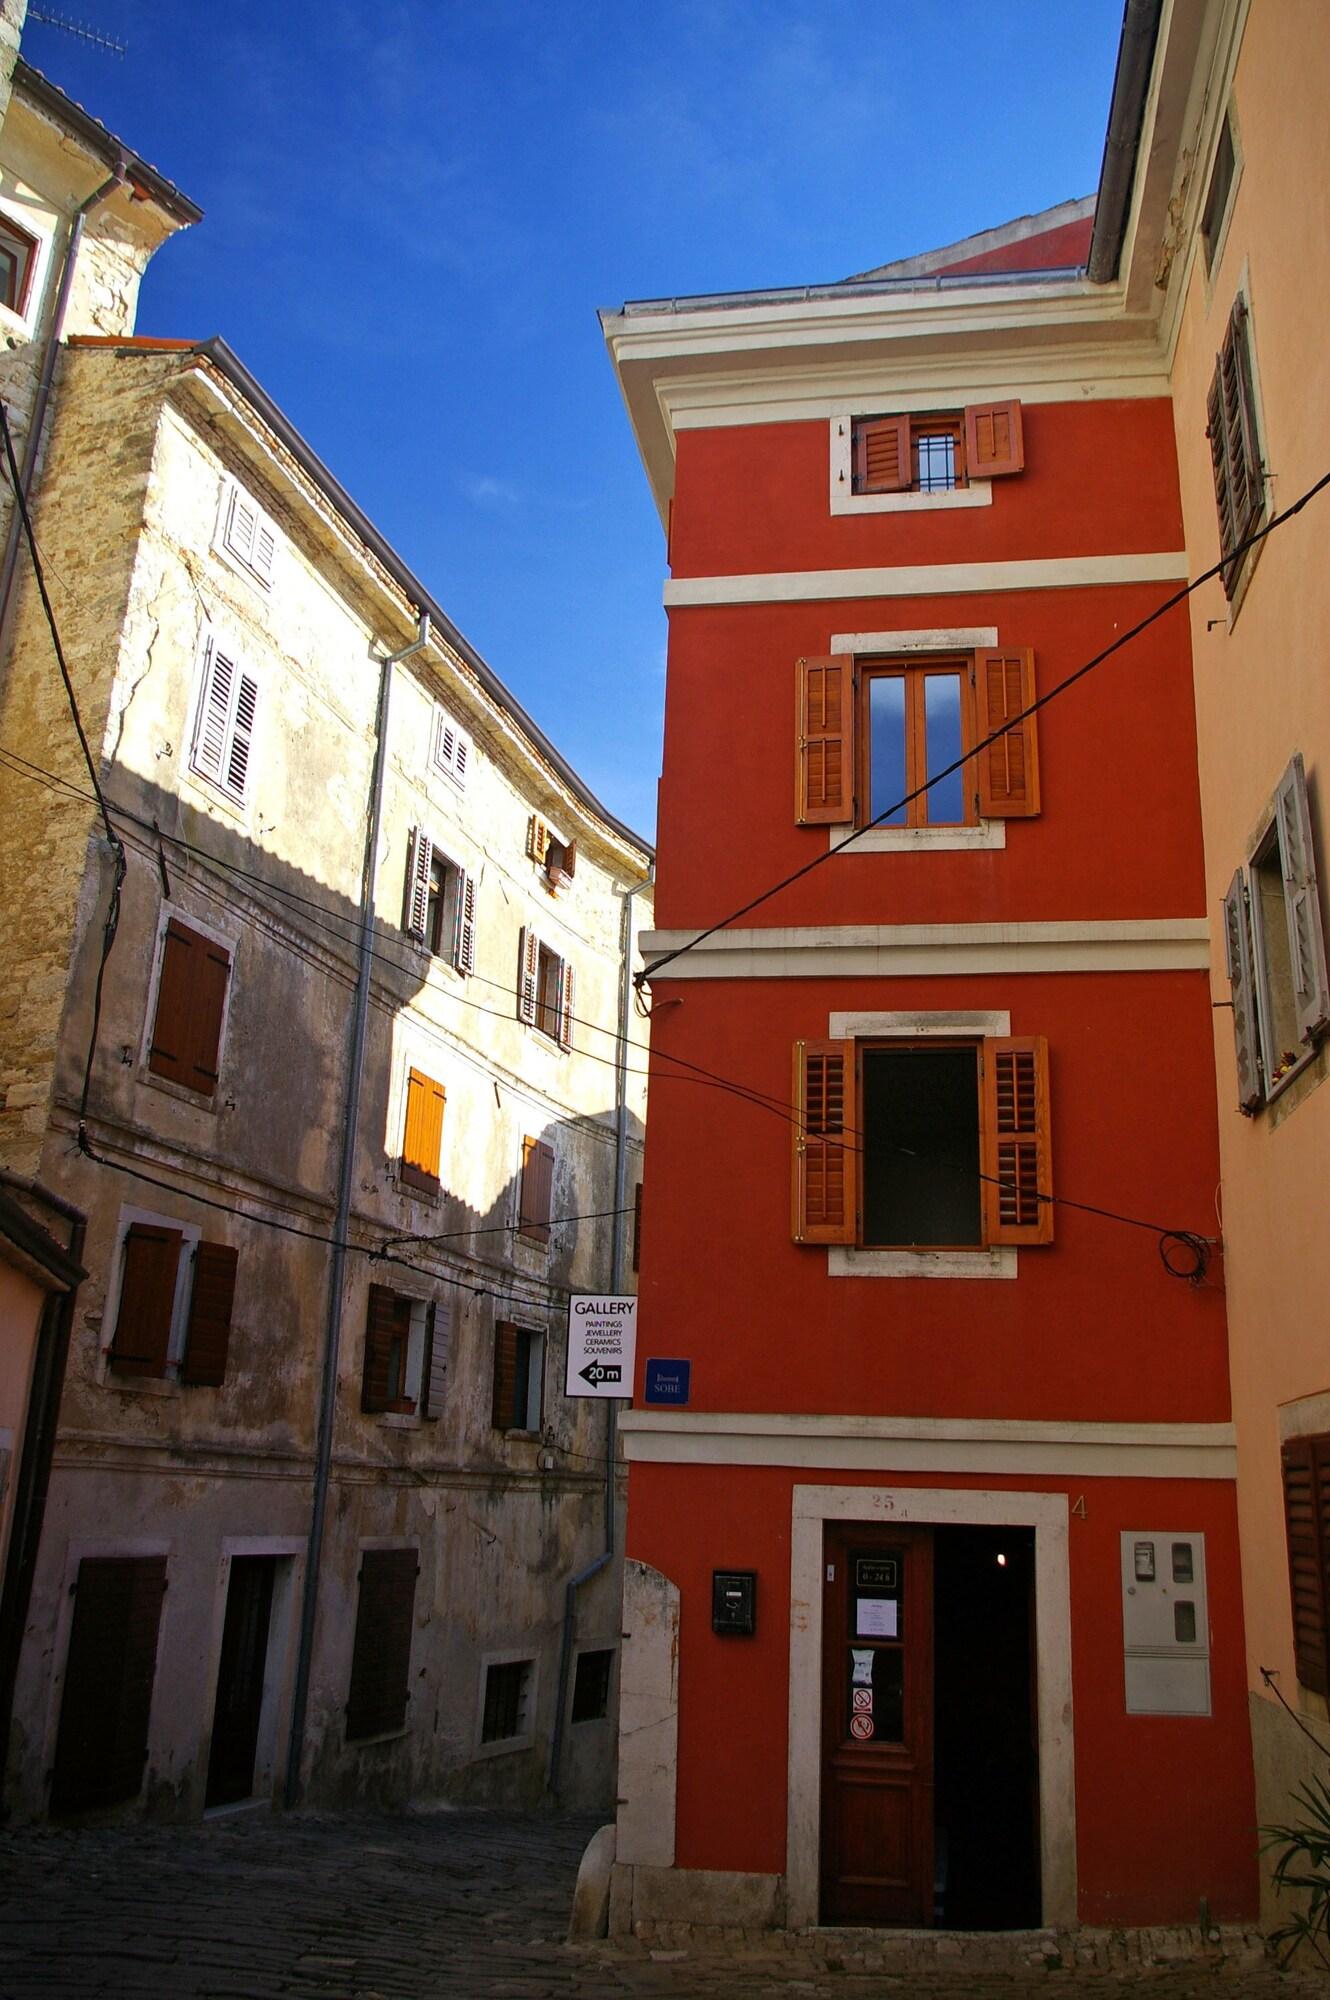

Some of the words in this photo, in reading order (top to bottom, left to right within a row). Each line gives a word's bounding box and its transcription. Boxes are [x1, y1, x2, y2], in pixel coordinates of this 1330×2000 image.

[574, 1301, 635, 1315] GALLERY
[585, 1320, 623, 1328] PAINTINGS
[584, 1329, 623, 1337] JEWELLERY
[585, 1338, 621, 1346] CERAMICS
[583, 1346, 623, 1355] SOUVENIRS
[588, 1367, 604, 1379] 20
[606, 1370, 619, 1379] m
[654, 1383, 680, 1393] SOBE
[1071, 1495, 1088, 1520] 4
